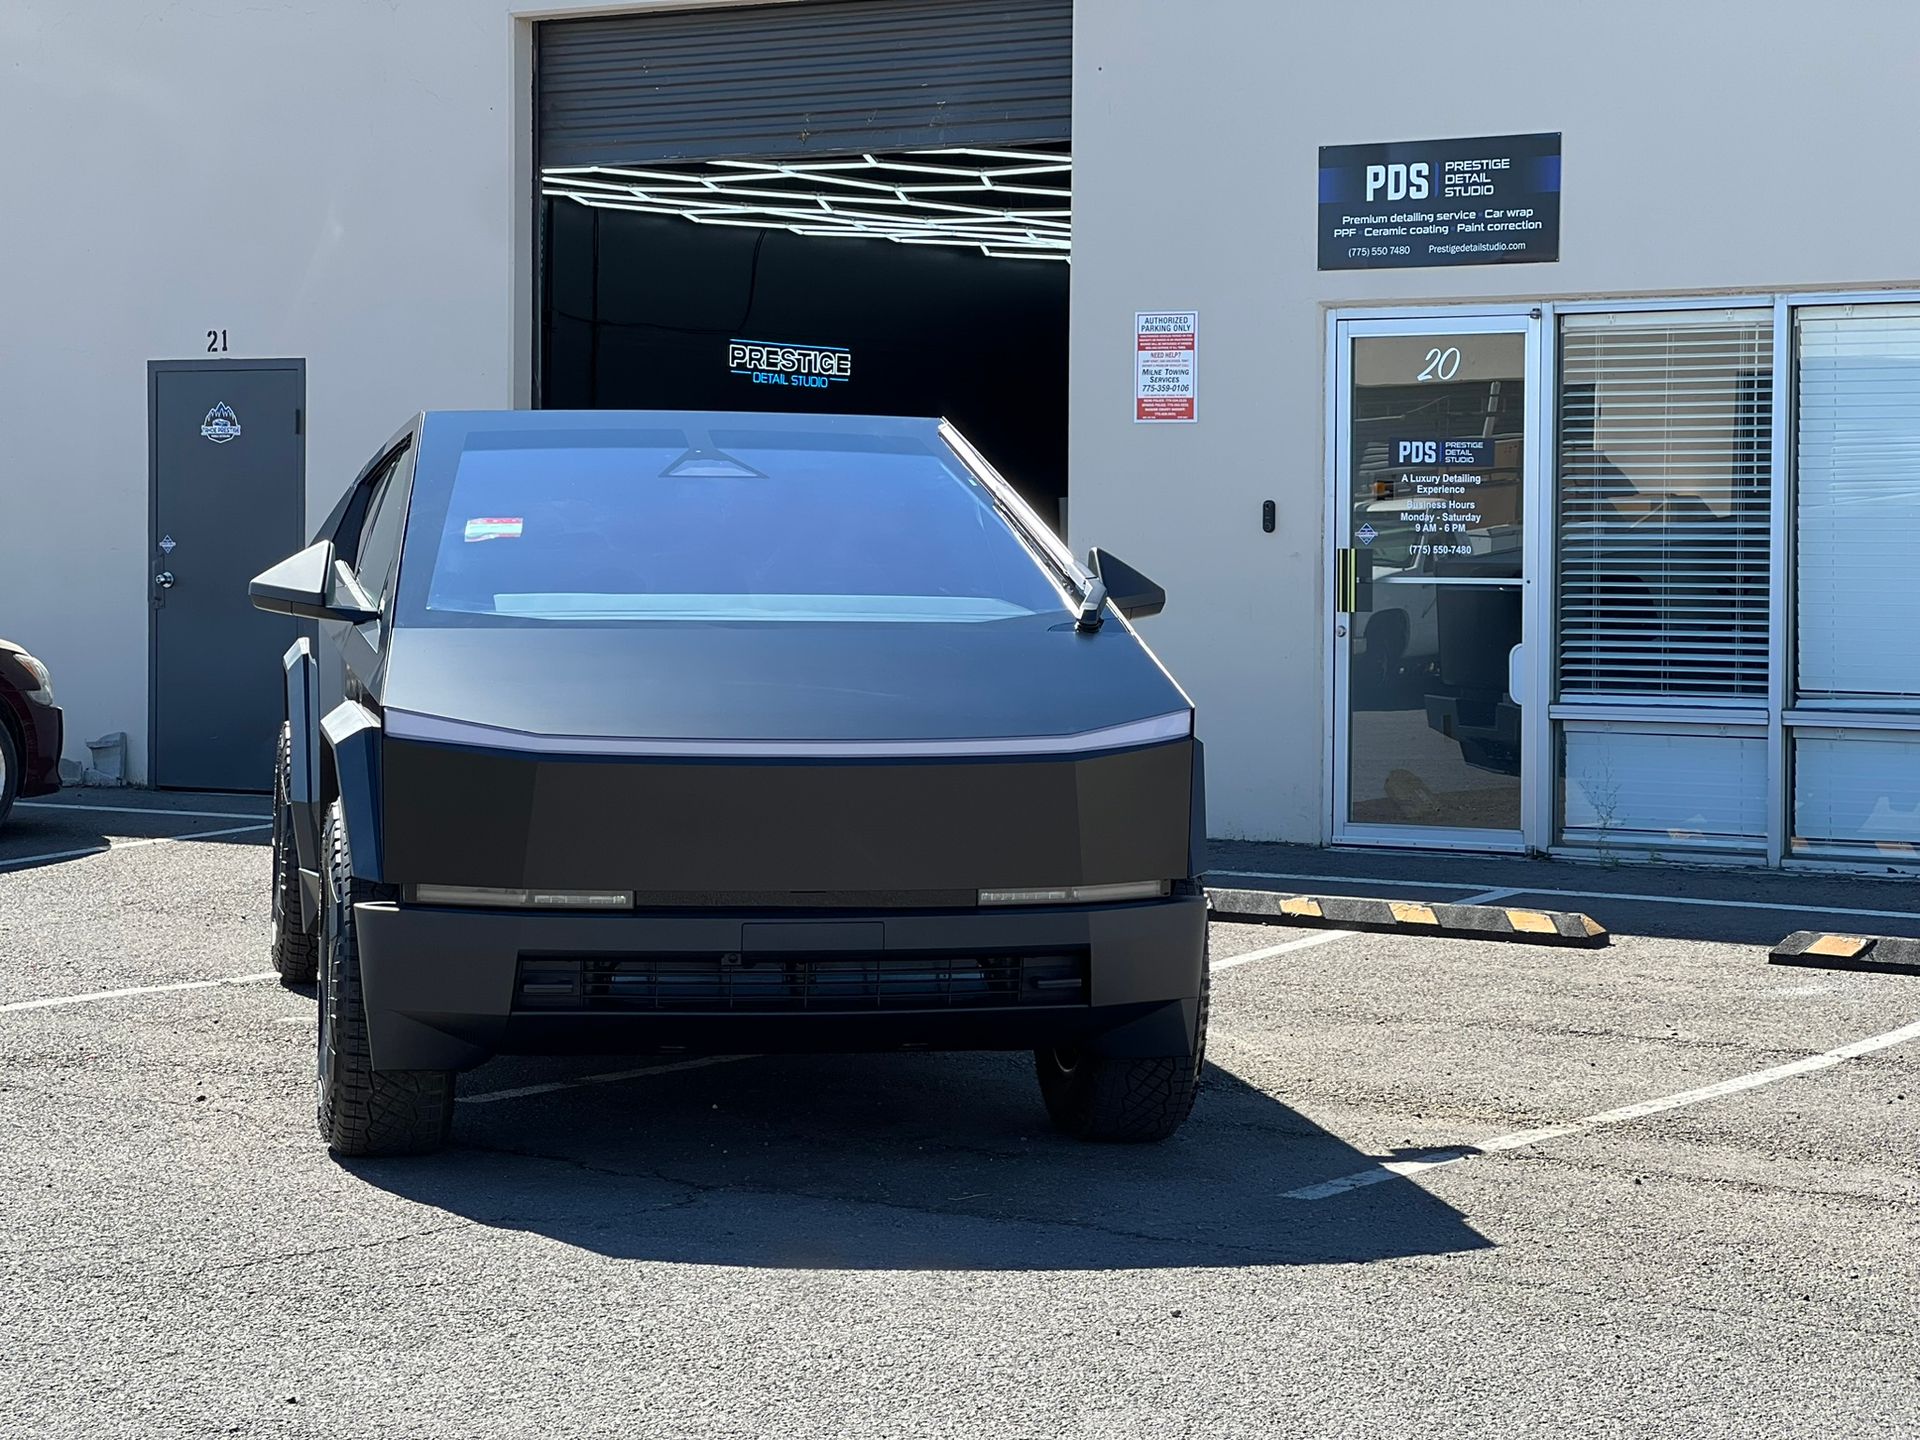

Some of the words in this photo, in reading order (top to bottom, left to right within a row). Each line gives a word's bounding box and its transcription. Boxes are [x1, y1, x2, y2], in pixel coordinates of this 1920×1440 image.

[1445, 158, 1510, 172] PRESTIGE
[1366, 162, 1429, 202] PDS
[1445, 173, 1491, 185] DETAIL
[1445, 185, 1494, 197] STUDIO
[1342, 213, 1388, 225] Premium
[1390, 210, 1434, 224] detailing
[1436, 210, 1476, 221] service
[1484, 208, 1504, 219] Car
[1506, 208, 1534, 219] wrap
[1333, 228, 1357, 238] PPF
[1364, 225, 1407, 237] Ceramic
[1409, 224, 1449, 236] coating
[1457, 222, 1485, 233] Paint
[1487, 220, 1542, 231] correction
[1348, 247, 1370, 258] (775)
[1372, 247, 1388, 256] 550
[1390, 246, 1410, 255] 7480
[1428, 241, 1526, 254] Prestigedetailstudio.com
[1144, 316, 1188, 324] AUTHORIZED
[207, 330, 228, 352] 21
[729, 344, 851, 375] PRESTIGE
[1417, 347, 1461, 381] 20
[752, 372, 789, 385] DETAIL
[791, 375, 828, 388] STUDIO
[1142, 384, 1189, 392] 775-359-0106
[1399, 441, 1437, 463] PDS
[1401, 474, 1408, 482] A
[1410, 474, 1441, 485] Luxury
[1443, 474, 1481, 485] Detailing
[1417, 485, 1465, 496] Experience
[1407, 500, 1447, 509] Business
[1449, 500, 1475, 509] Hours
[1401, 513, 1434, 524] Monday
[1442, 512, 1481, 523] Saturday
[1415, 524, 1421, 532] 9
[1423, 524, 1436, 532] AM
[1444, 524, 1450, 532] 6
[1452, 524, 1466, 532] PM
[1409, 545, 1431, 555] (775)
[1433, 545, 1471, 554] 550-7480
